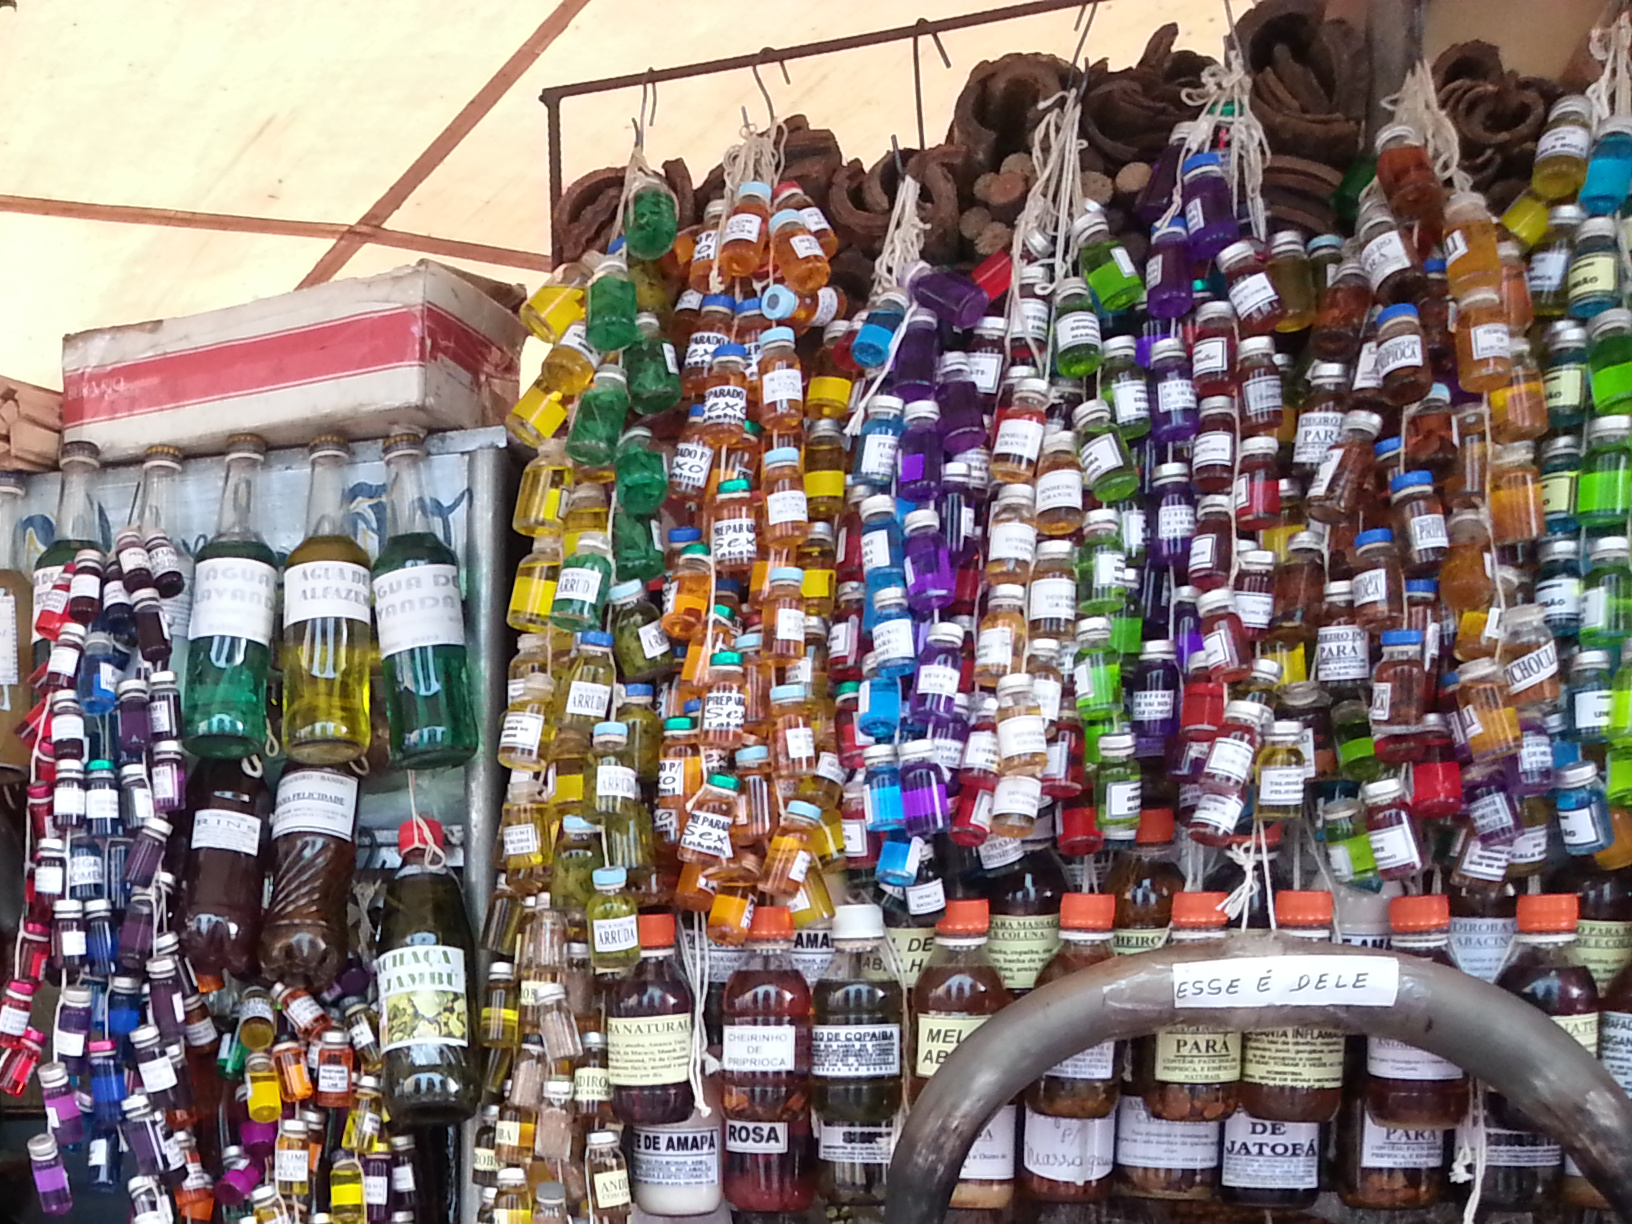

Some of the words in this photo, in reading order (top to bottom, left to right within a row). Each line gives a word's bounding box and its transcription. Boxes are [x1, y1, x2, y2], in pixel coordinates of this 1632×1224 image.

[378, 948, 453, 974] CHAÇA
[1176, 978, 1241, 999] ESSE
[1256, 970, 1273, 992] É
[1289, 972, 1369, 992] DELE
[728, 1032, 788, 1042] CHEIRINHO
[844, 1031, 895, 1042] COPAIBA
[1175, 1035, 1230, 1054] PARÁ
[747, 1046, 762, 1054] DE
[727, 1056, 786, 1067] PRIPRIOCA
[728, 1124, 780, 1144] ROSA
[1250, 1122, 1286, 1136] DE
[644, 1134, 661, 1150] DE
[668, 1130, 716, 1150] AMAPÁ
[1226, 1139, 1317, 1158] JATOBÁ
